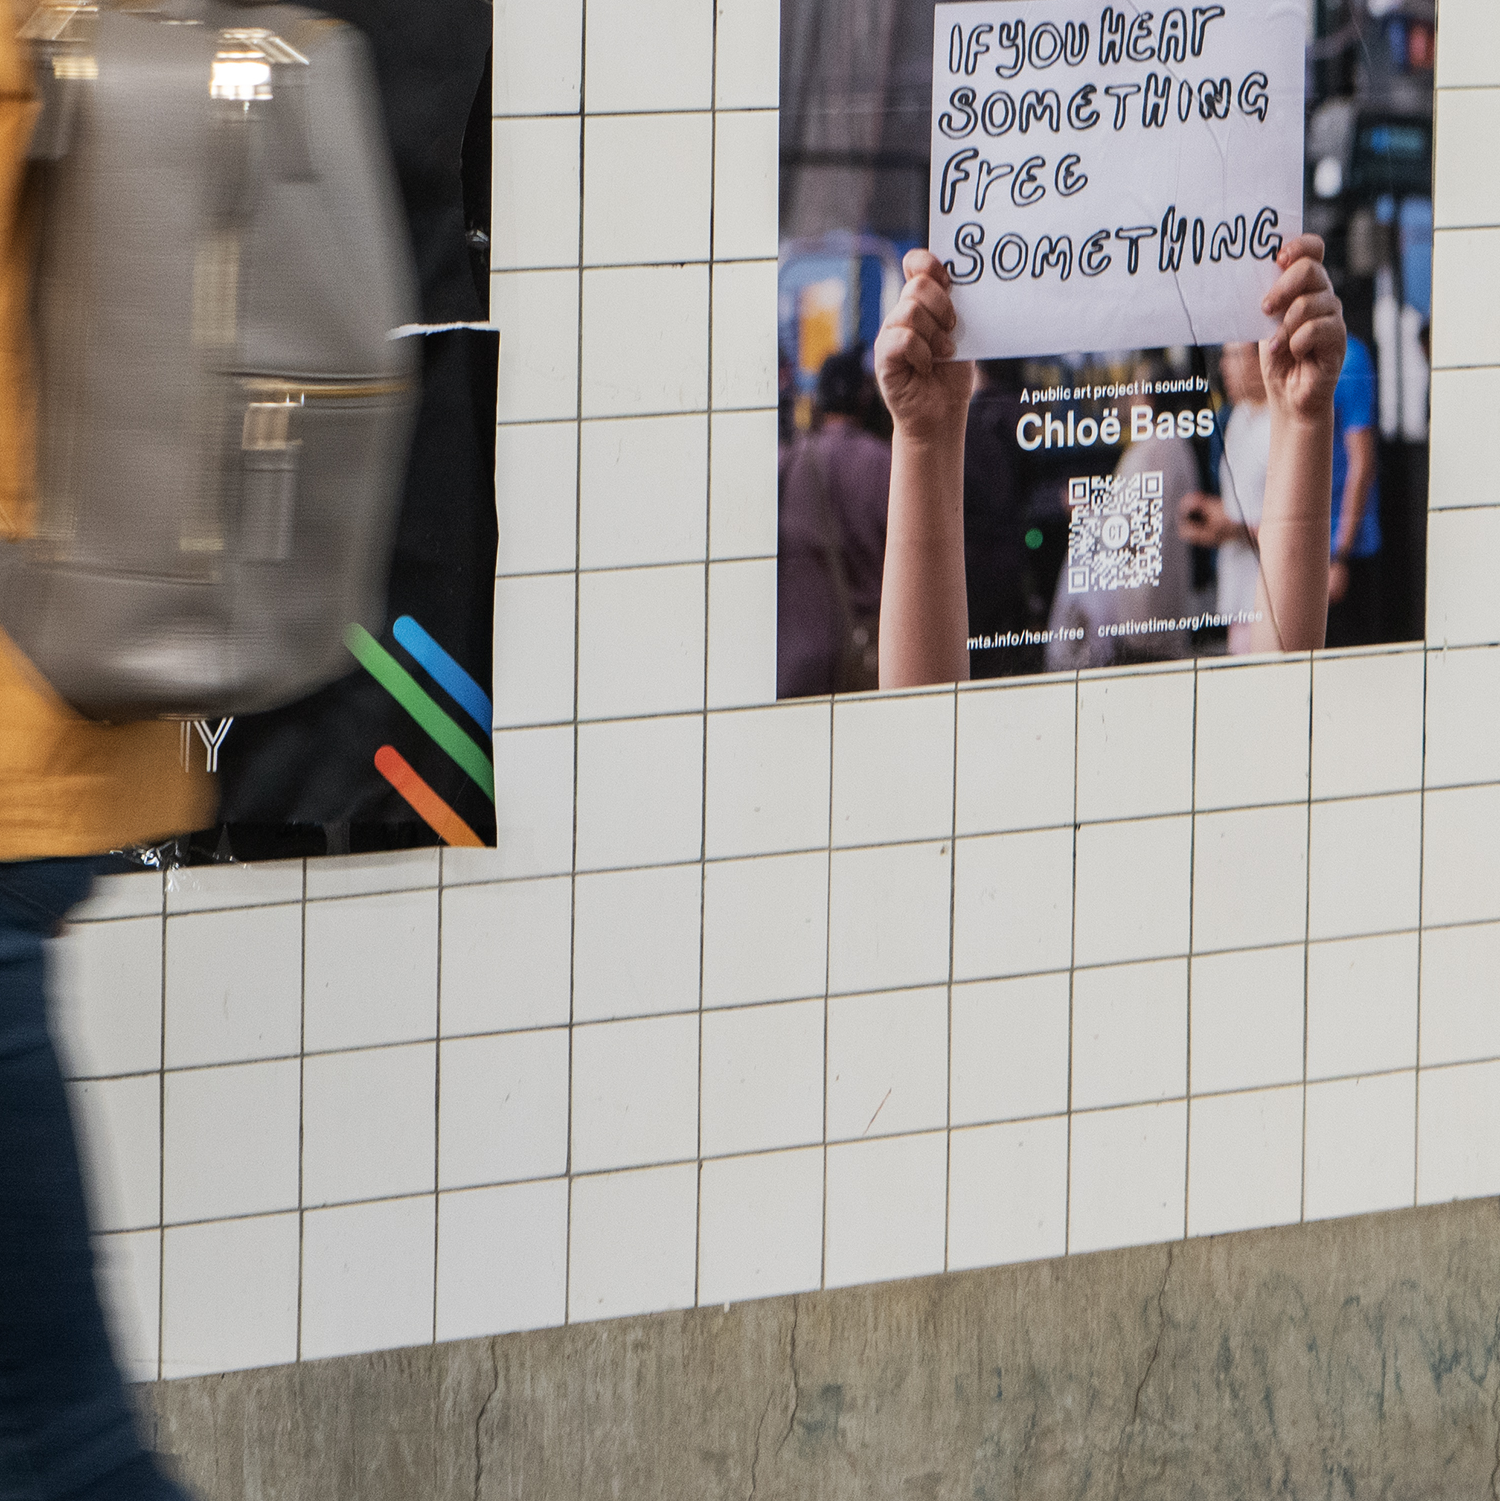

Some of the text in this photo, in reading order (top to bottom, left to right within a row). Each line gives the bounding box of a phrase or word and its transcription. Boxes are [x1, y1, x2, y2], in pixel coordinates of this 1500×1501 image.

[949, 22, 994, 76] IF
[938, 70, 1269, 140] SOMETHING
[943, 204, 1283, 286] SOMETHING
[1020, 375, 1209, 405] A public art project in sound by
[1016, 403, 1215, 451] Chloë Bass
[966, 625, 1085, 651] mta.info/hear-free
[1098, 609, 1263, 638] creativetime.org/hear-free
